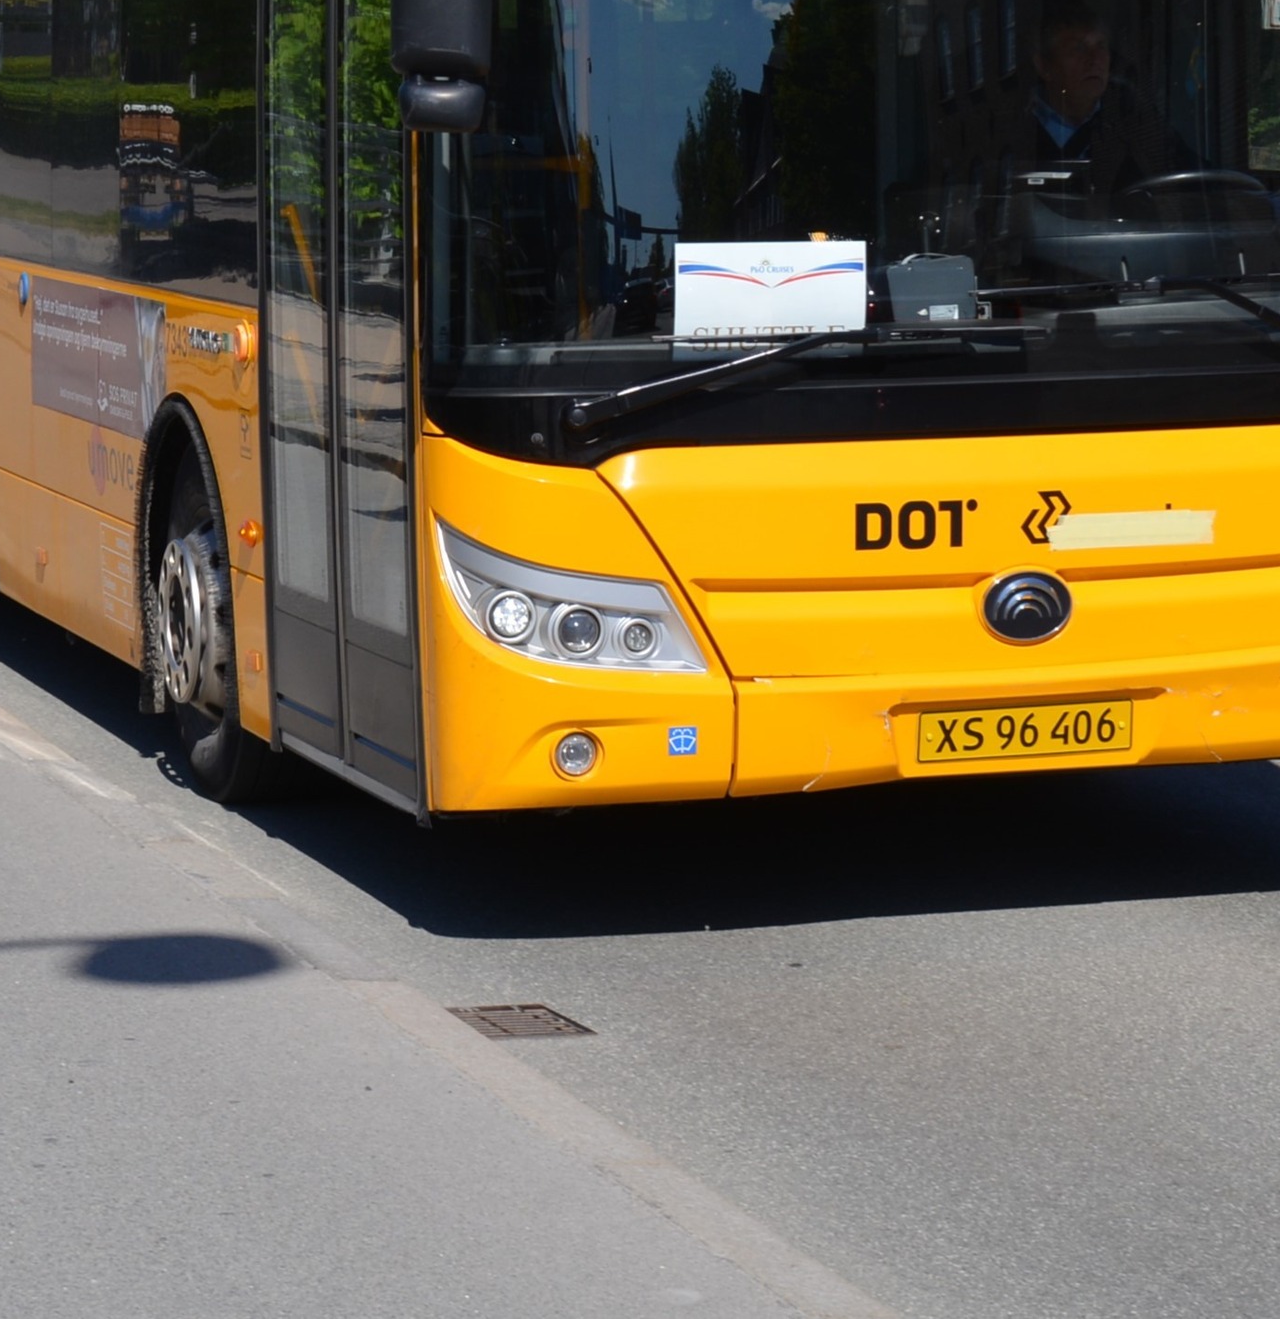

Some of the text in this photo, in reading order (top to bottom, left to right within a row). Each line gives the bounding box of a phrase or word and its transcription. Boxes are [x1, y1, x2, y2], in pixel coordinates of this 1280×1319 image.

[855, 499, 978, 550] DOT
[935, 707, 1116, 753] XS 96 406
